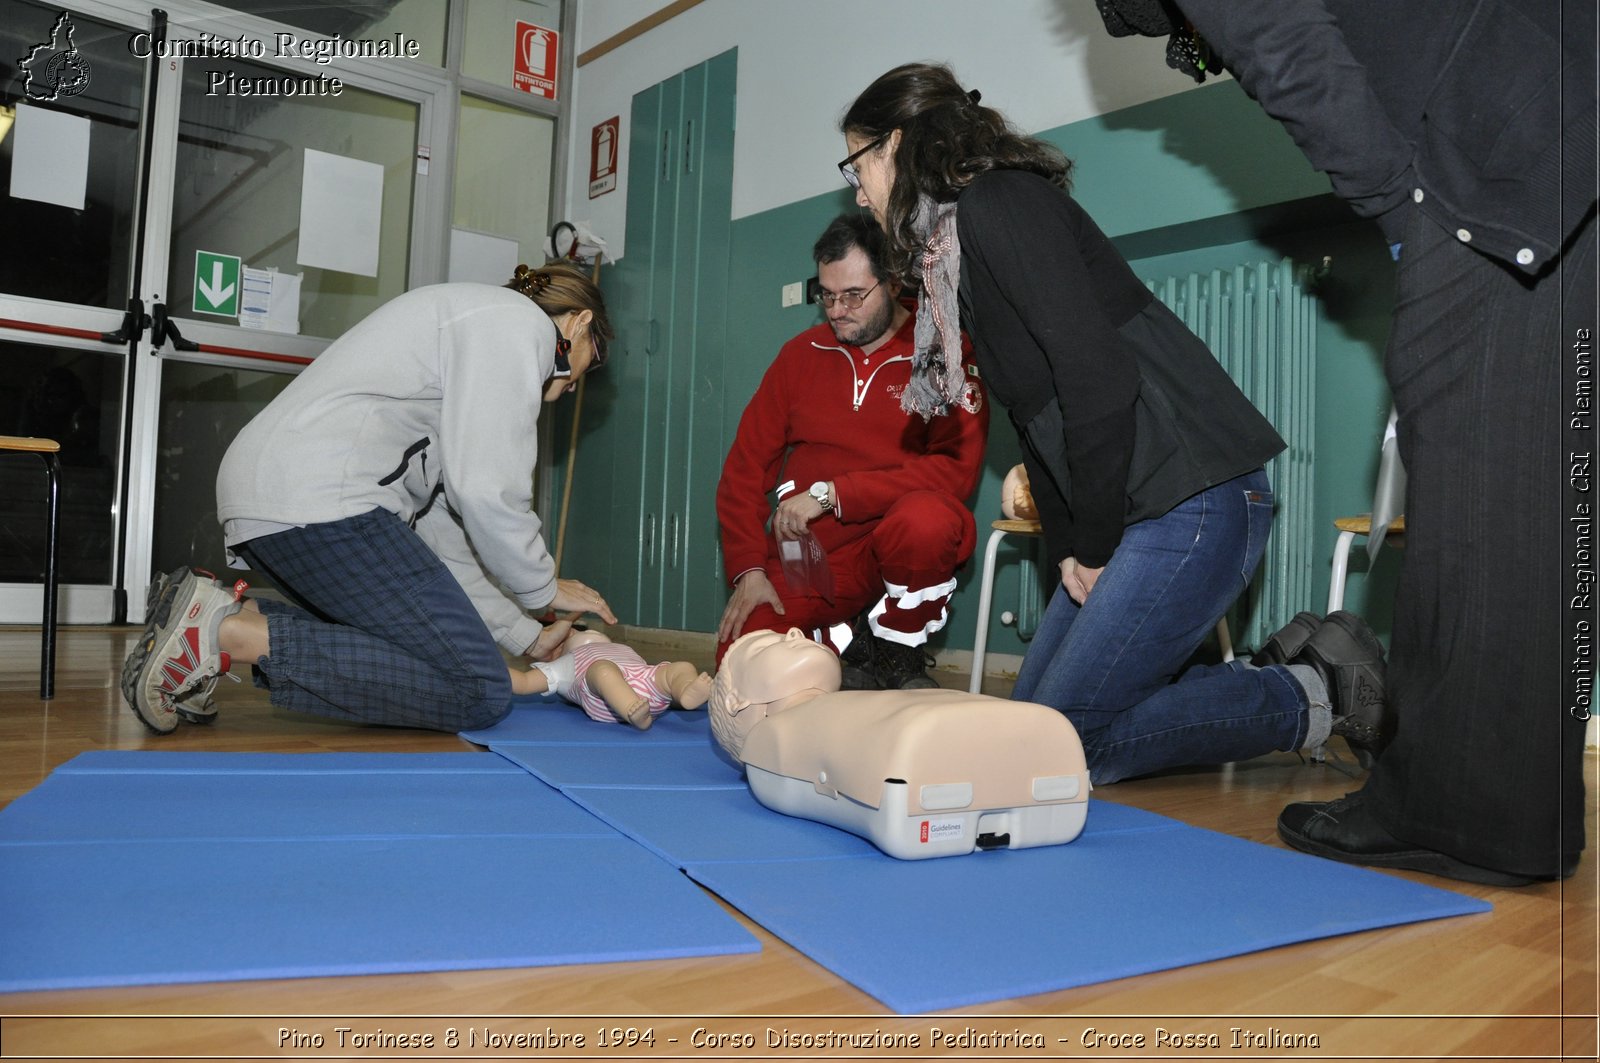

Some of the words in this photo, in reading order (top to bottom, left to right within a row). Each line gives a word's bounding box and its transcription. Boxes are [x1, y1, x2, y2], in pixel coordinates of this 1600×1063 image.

[170, 61, 177, 71] 5
[515, 74, 553, 90] ESTINTORE
[930, 823, 961, 832] Guidelines
